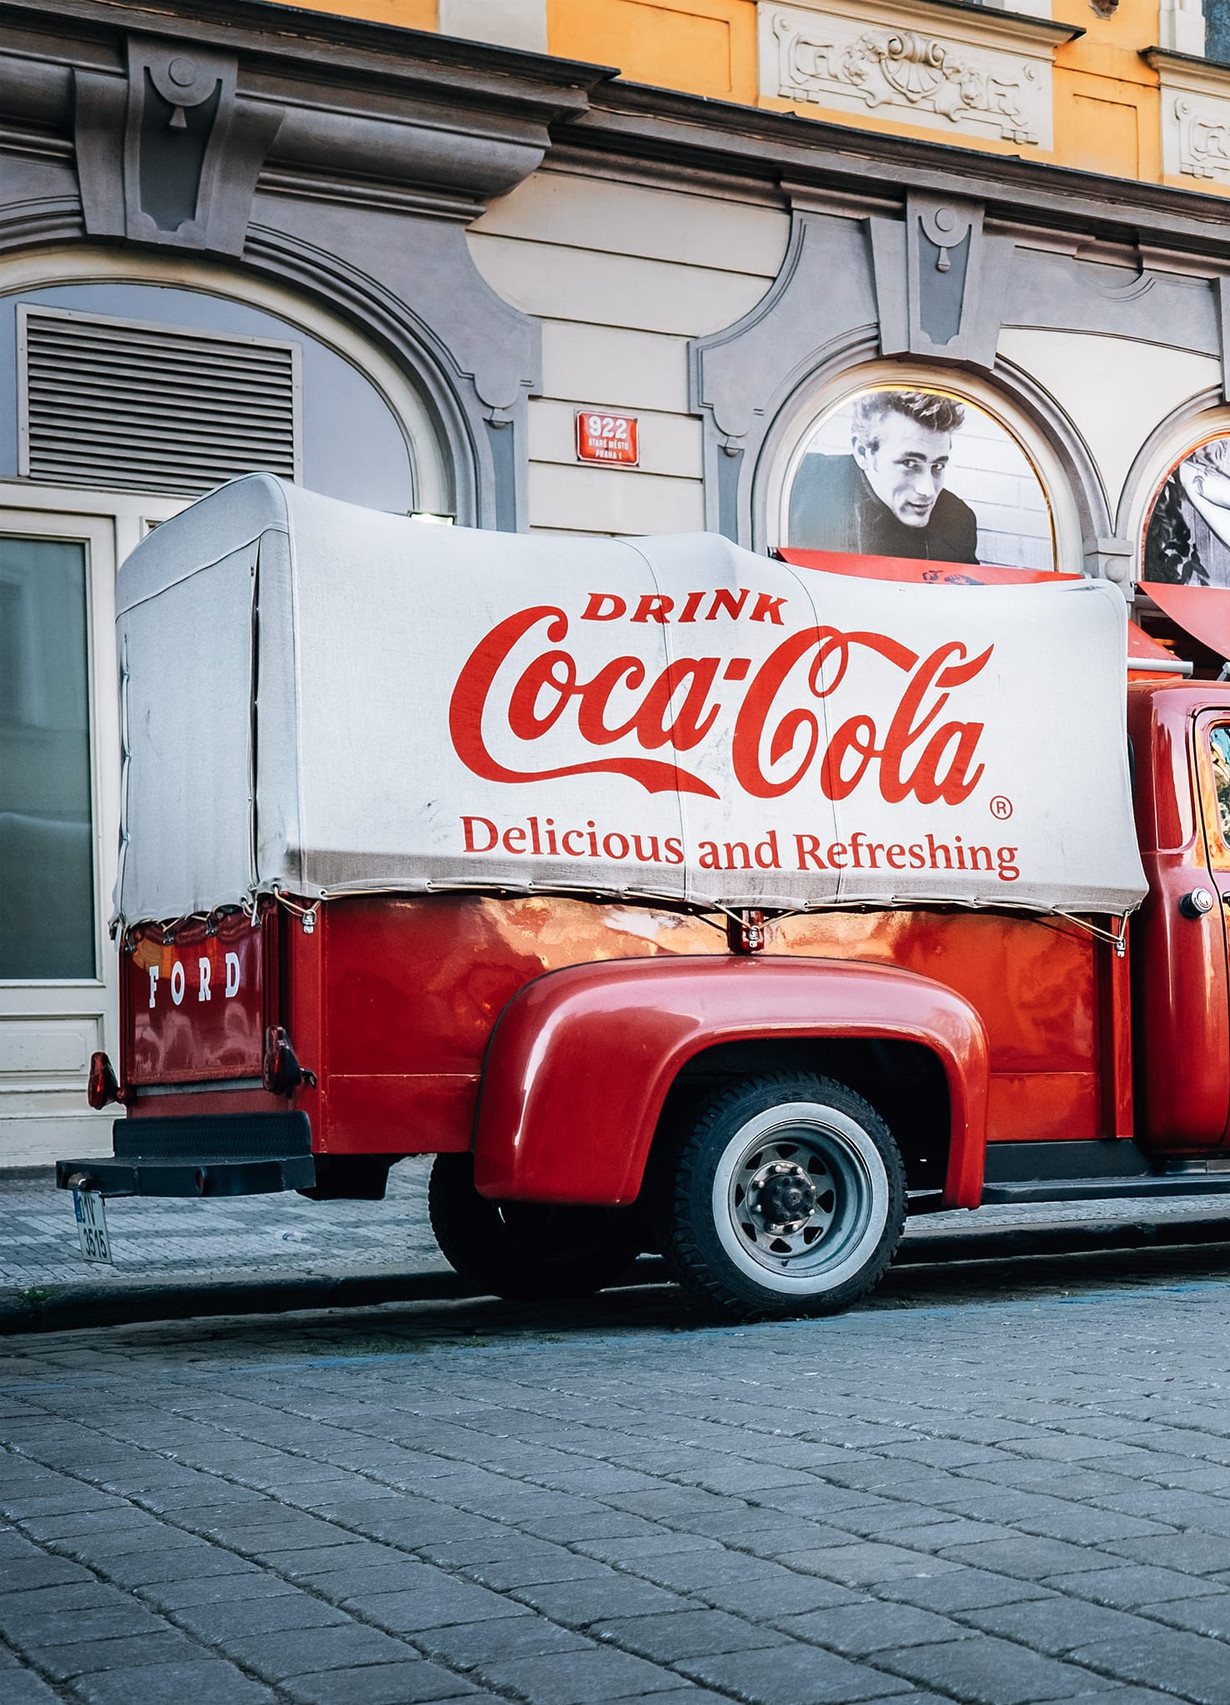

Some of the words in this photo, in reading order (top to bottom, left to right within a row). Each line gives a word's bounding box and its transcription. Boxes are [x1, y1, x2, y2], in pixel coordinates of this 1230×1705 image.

[588, 416, 627, 439] 922
[595, 449, 617, 459] PRAHA
[580, 588, 789, 626] DRINK
[449, 605, 995, 805] Coca-Cola
[459, 814, 684, 865] Delicious
[698, 830, 782, 870] and
[793, 832, 1019, 881] Refreshing
[149, 952, 240, 1008] FORD
[83, 1227, 108, 1258] 3515
